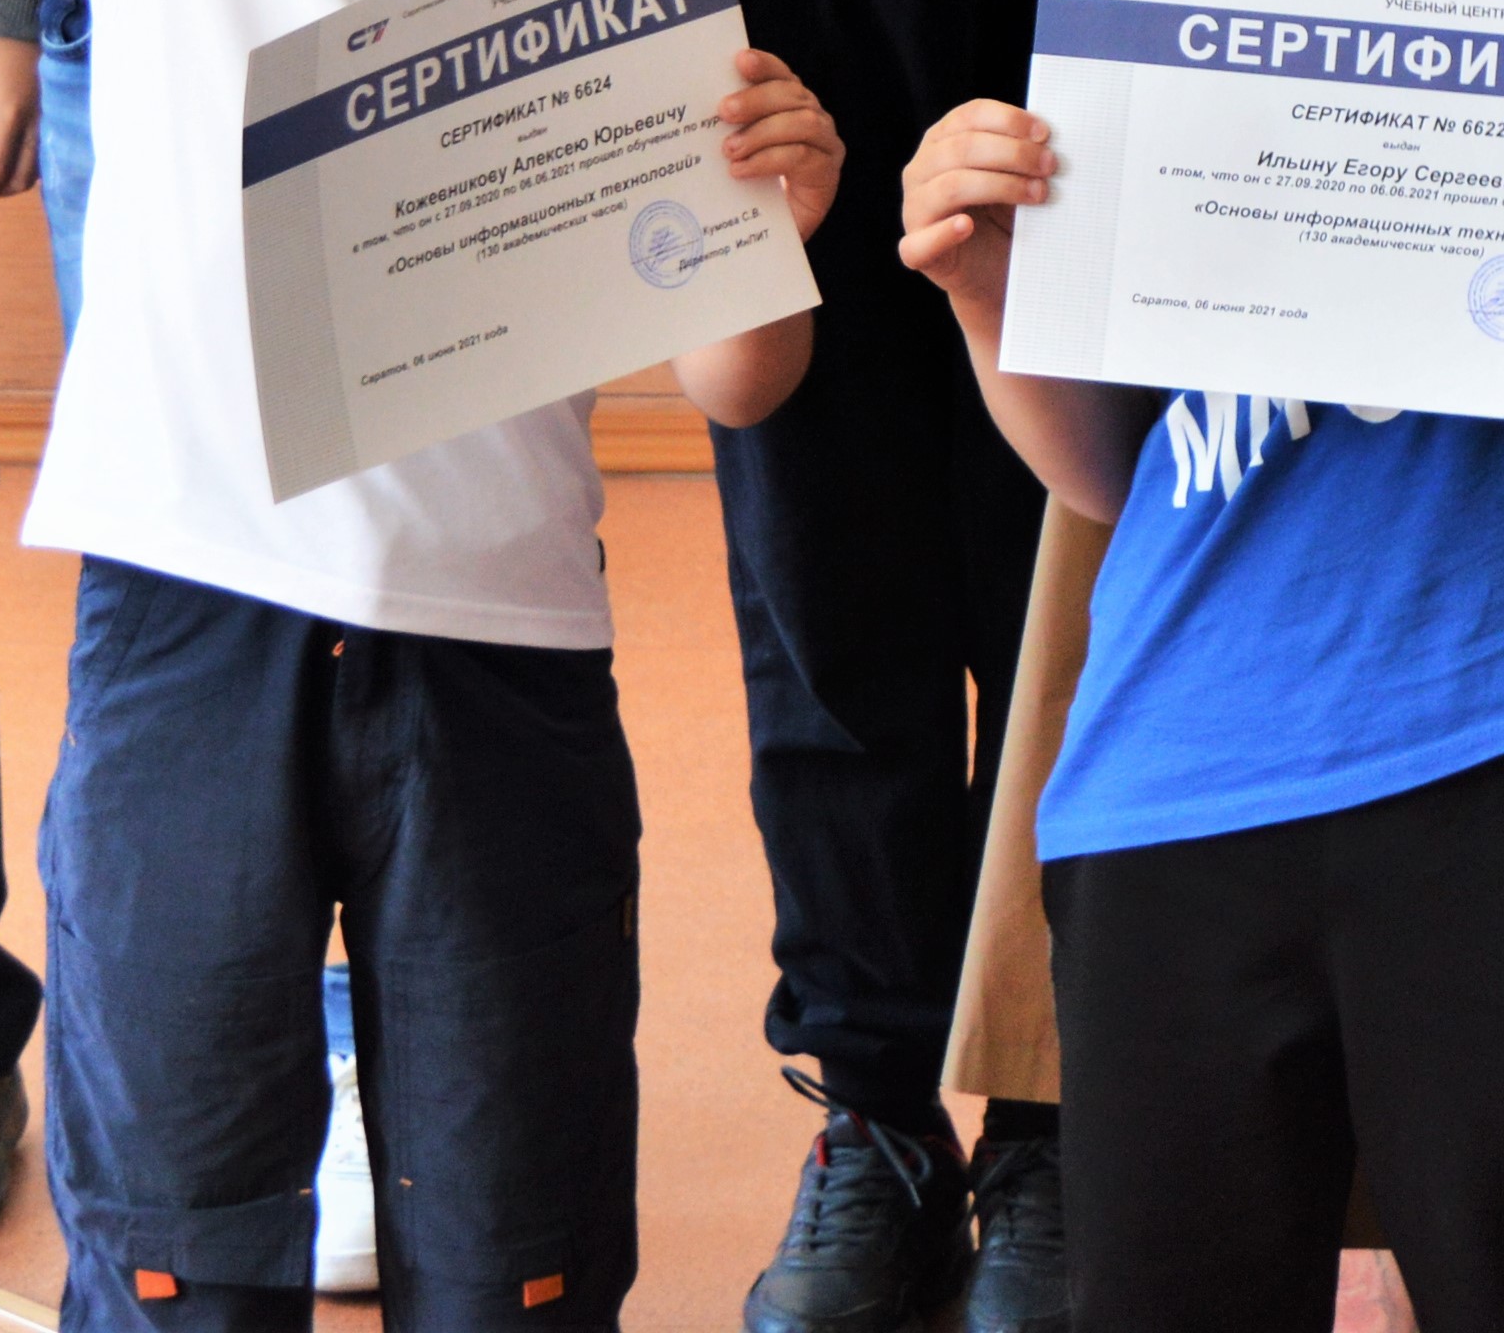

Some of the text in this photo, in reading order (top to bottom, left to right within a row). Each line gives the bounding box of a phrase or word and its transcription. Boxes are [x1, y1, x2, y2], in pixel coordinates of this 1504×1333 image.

[441, 96, 547, 148] СЕРТИФИКАТ
[574, 75, 611, 100] 6624
[1292, 104, 1429, 130] СЕРТИФИКАТ
[395, 105, 686, 218] Кожевникову Алексею Юрьевичу
[1257, 151, 1337, 177] Ильину
[1343, 158, 1408, 183] Егору
[459, 191, 595, 249] информационных
[1284, 211, 1452, 236] информационных
[1299, 230, 1484, 258] (130 академических часов)
